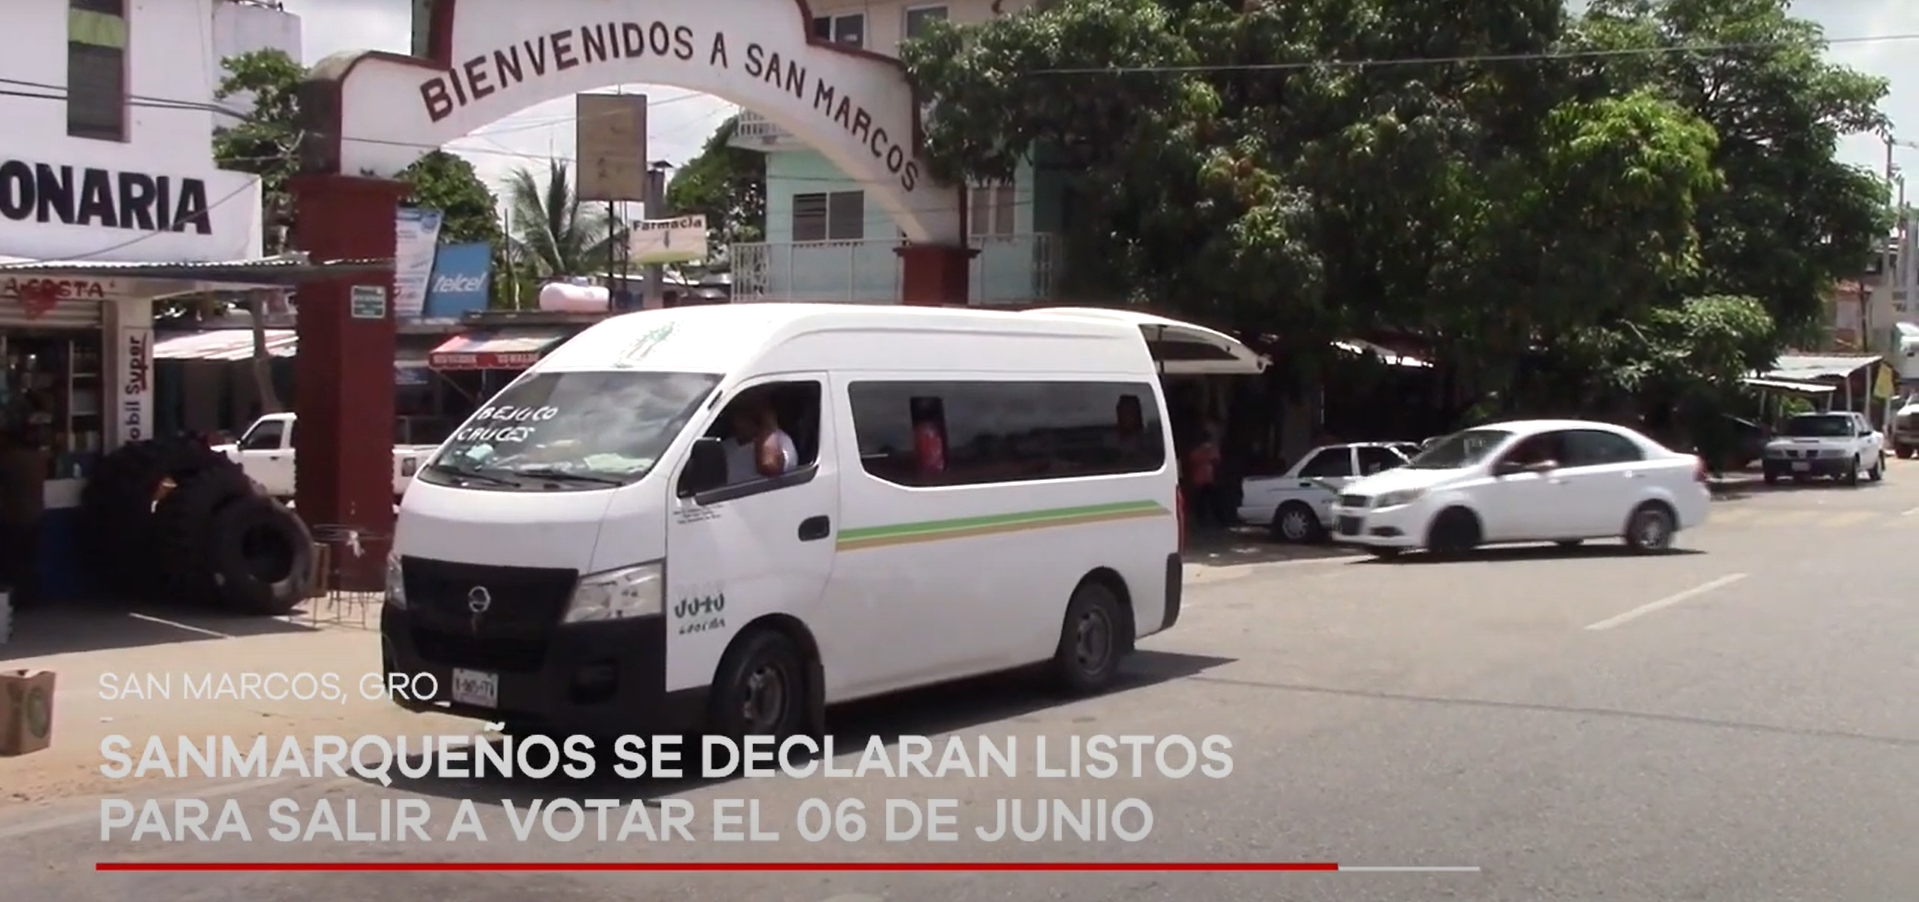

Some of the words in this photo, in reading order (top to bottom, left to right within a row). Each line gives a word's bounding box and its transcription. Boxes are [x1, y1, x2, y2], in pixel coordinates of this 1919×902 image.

[420, 21, 694, 123] BIENVENIDOS
[709, 32, 728, 69] A
[744, 43, 806, 100] SAN
[813, 78, 918, 192] MARCOS
[0, 160, 213, 236] ONARIA
[432, 271, 488, 293] telcel
[476, 405, 559, 422] BEJUCO
[457, 426, 536, 442] CRUCES
